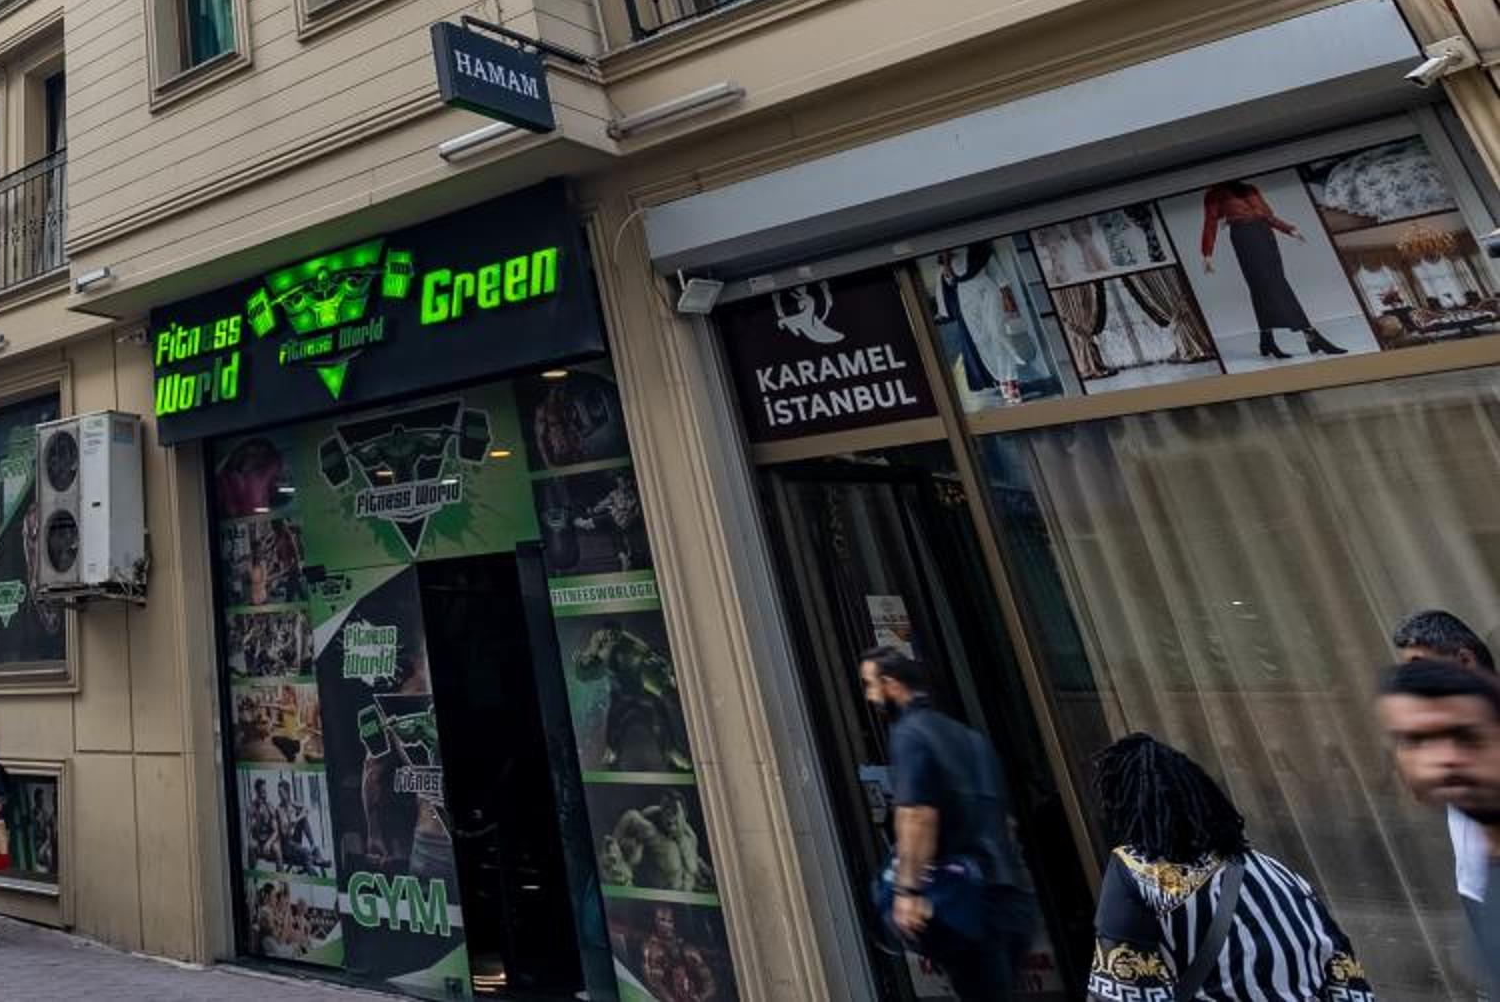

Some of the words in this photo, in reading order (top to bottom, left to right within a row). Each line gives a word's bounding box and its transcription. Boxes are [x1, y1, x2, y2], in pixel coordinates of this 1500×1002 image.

[453, 49, 540, 100] HAMAM
[420, 246, 560, 326] Green
[756, 344, 906, 393] KARAMEL
[763, 379, 917, 427] İSTANBUL
[347, 870, 451, 937] GYM
